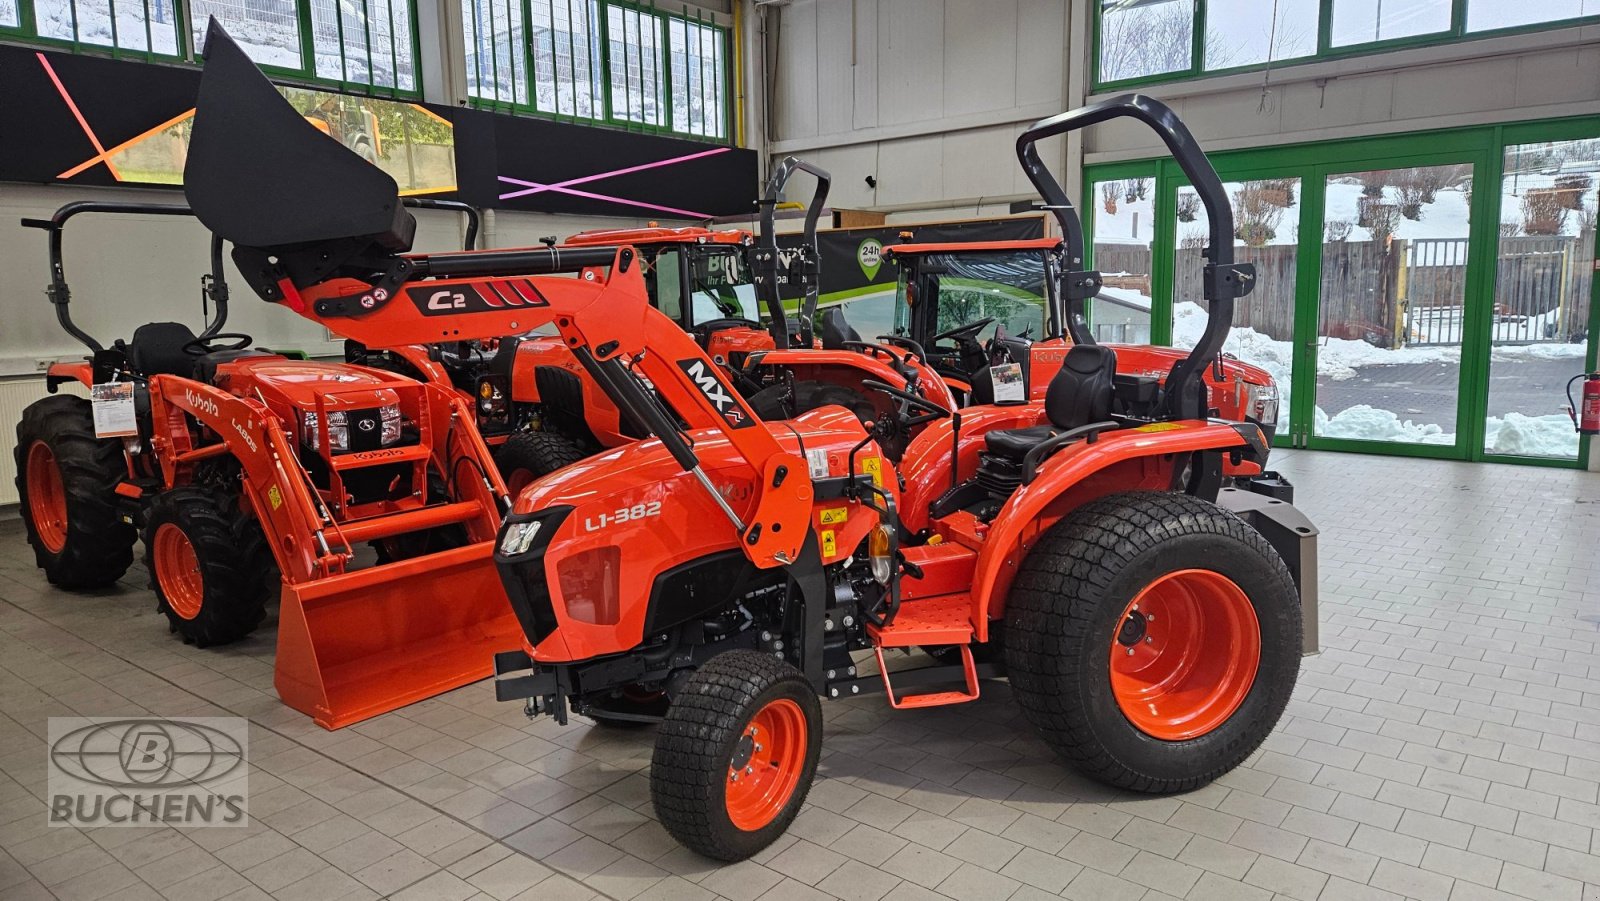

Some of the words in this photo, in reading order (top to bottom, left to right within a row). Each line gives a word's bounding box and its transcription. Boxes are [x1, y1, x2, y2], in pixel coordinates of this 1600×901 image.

[862, 246, 880, 256] 24h
[427, 290, 467, 311] C2
[687, 360, 735, 413] MX
[185, 388, 219, 418] Kubota
[353, 449, 405, 460] Kubota
[585, 501, 662, 532] L1-382
